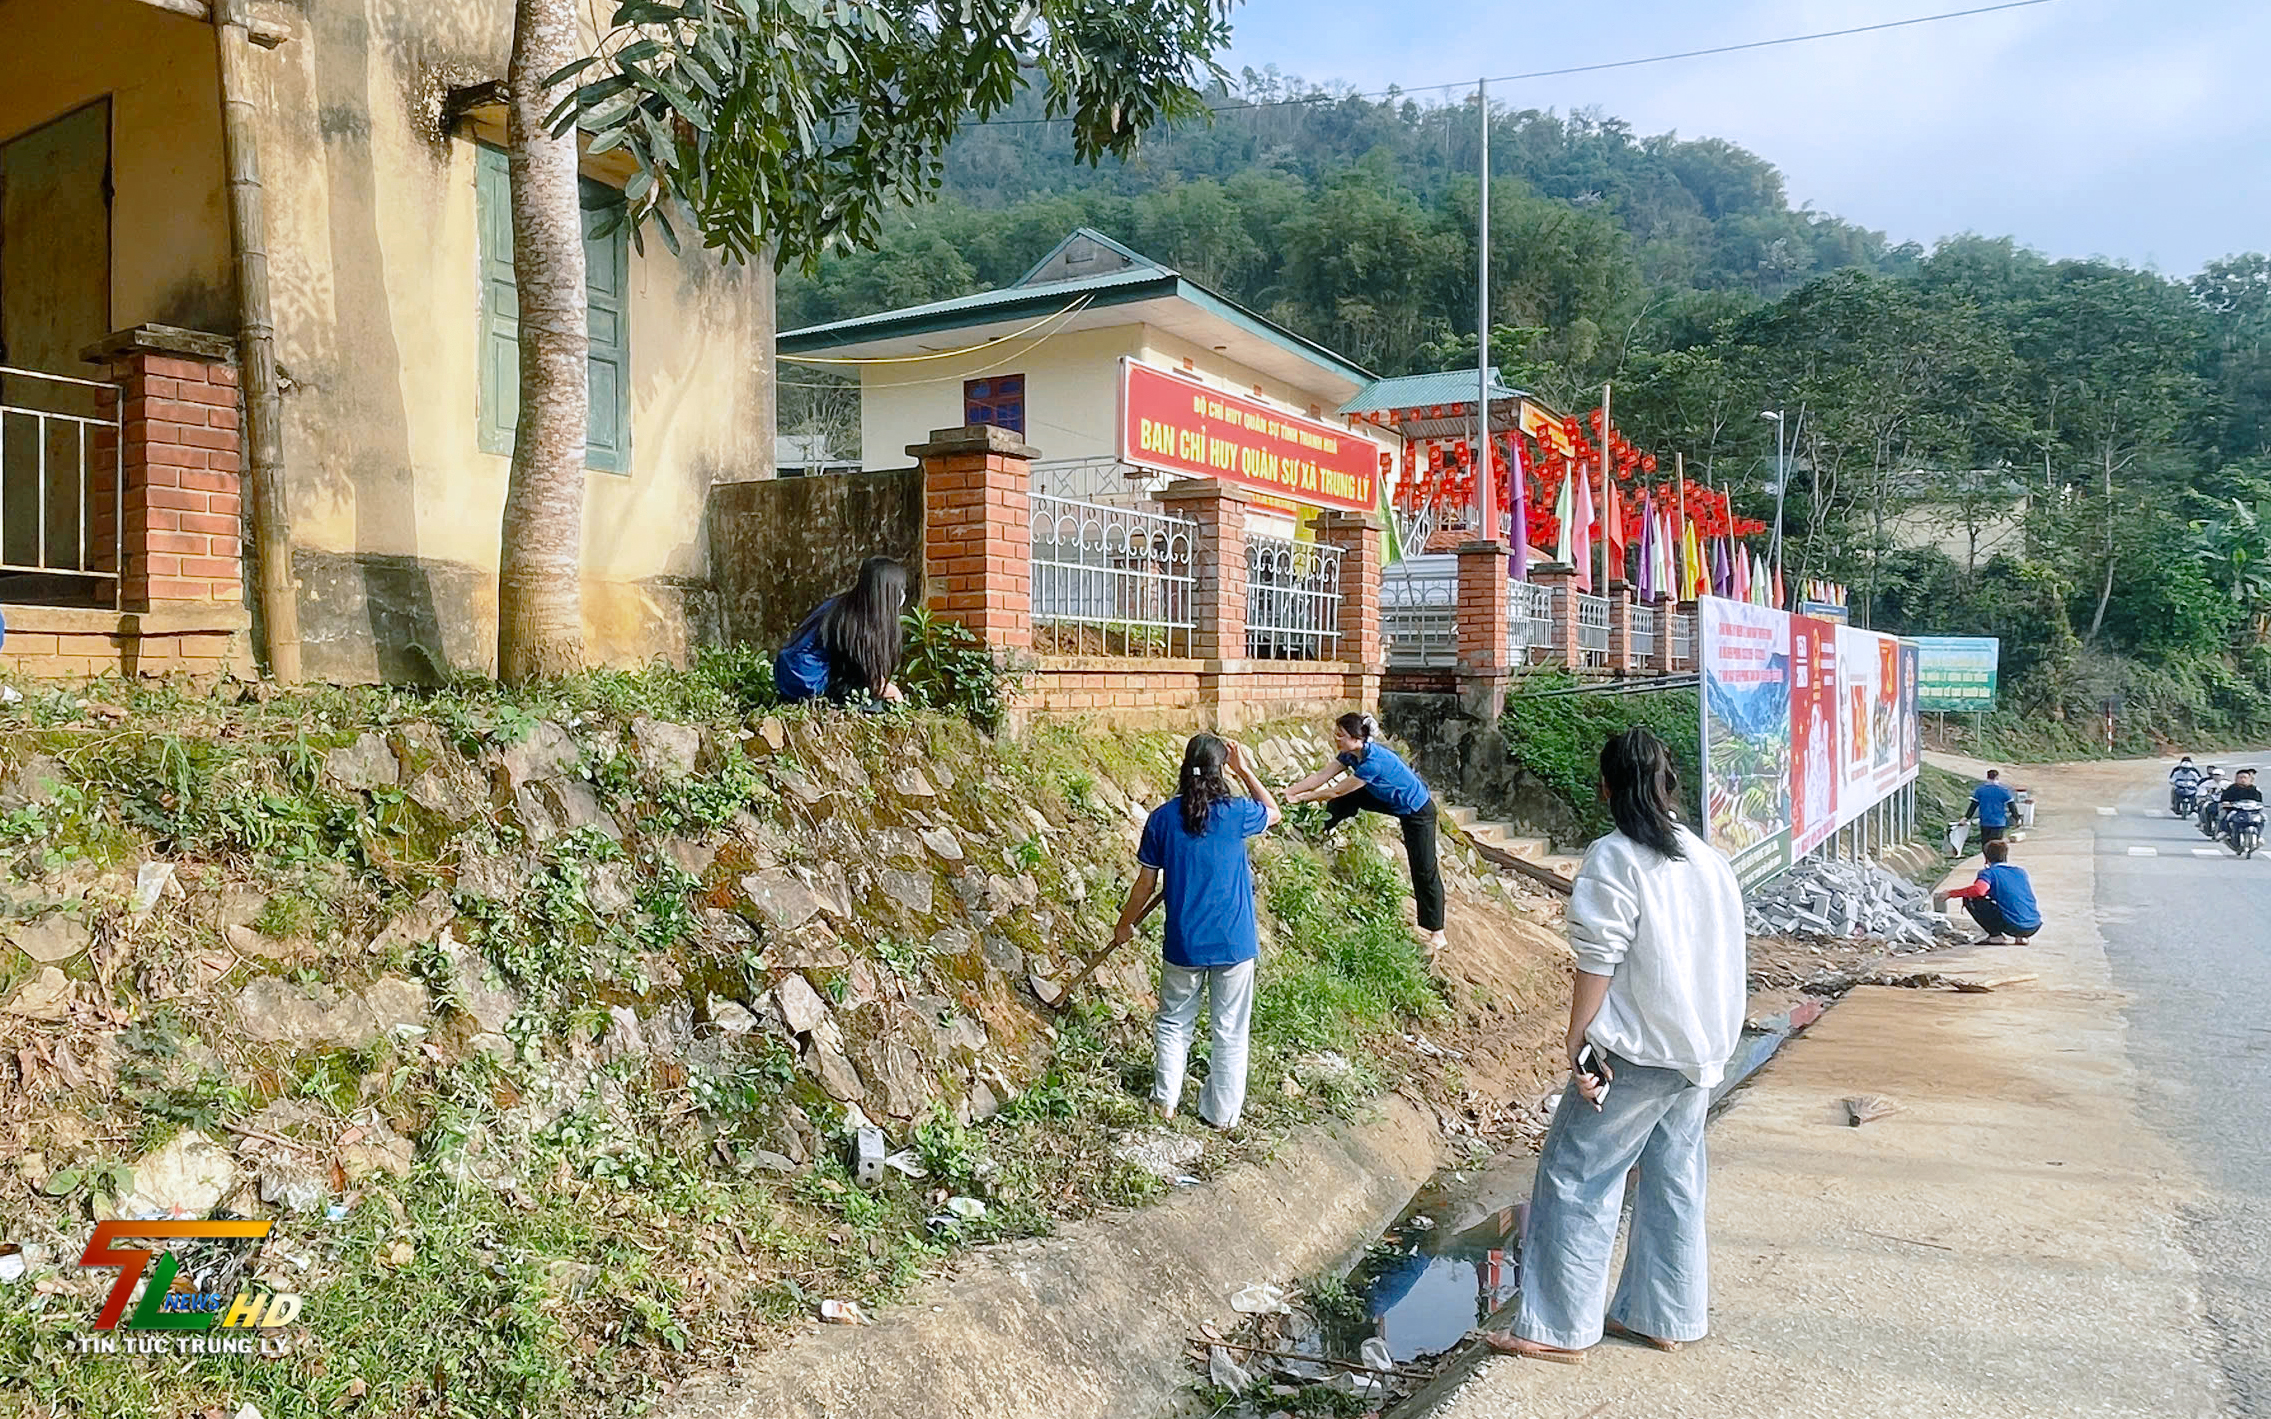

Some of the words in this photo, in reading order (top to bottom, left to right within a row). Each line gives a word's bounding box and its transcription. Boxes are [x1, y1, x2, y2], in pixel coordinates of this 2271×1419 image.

[1225, 406, 1242, 426] HUY
[1244, 412, 1267, 434] QUÂN
[1141, 417, 1175, 457] BAN
[1180, 425, 1206, 464] CHỈ
[1210, 437, 1239, 472] HUY
[1242, 446, 1278, 482] QUÂN
[1281, 457, 1300, 492] SỰ
[1301, 460, 1317, 492] XÃ
[1319, 468, 1356, 500] TRUNG
[1357, 473, 1370, 503] LÝ
